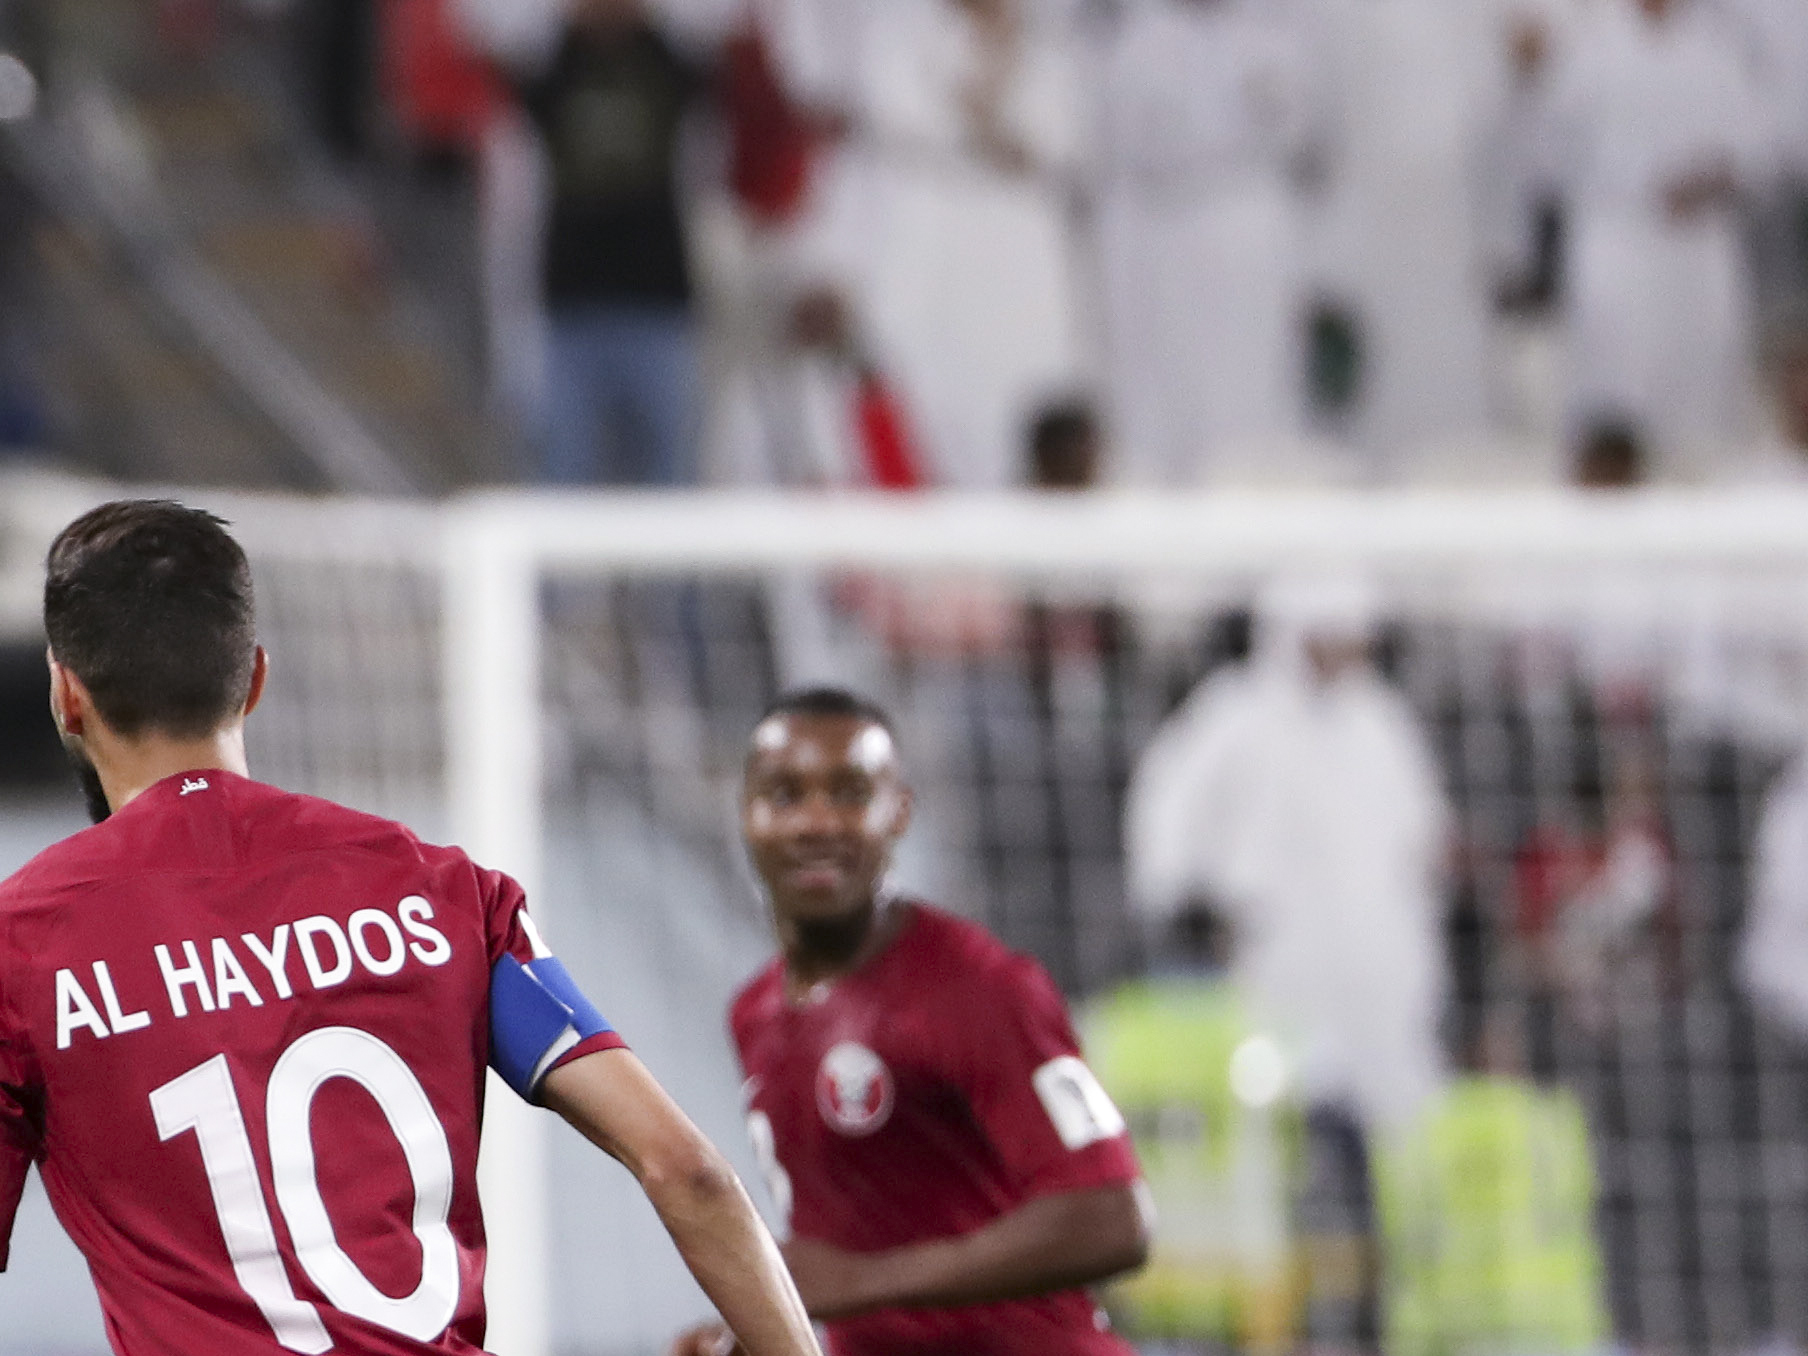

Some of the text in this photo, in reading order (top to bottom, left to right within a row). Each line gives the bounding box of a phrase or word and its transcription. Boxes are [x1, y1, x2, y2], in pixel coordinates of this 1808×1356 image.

[55, 895, 452, 1050] AL HAYDOS
[148, 1025, 460, 1356] 10
